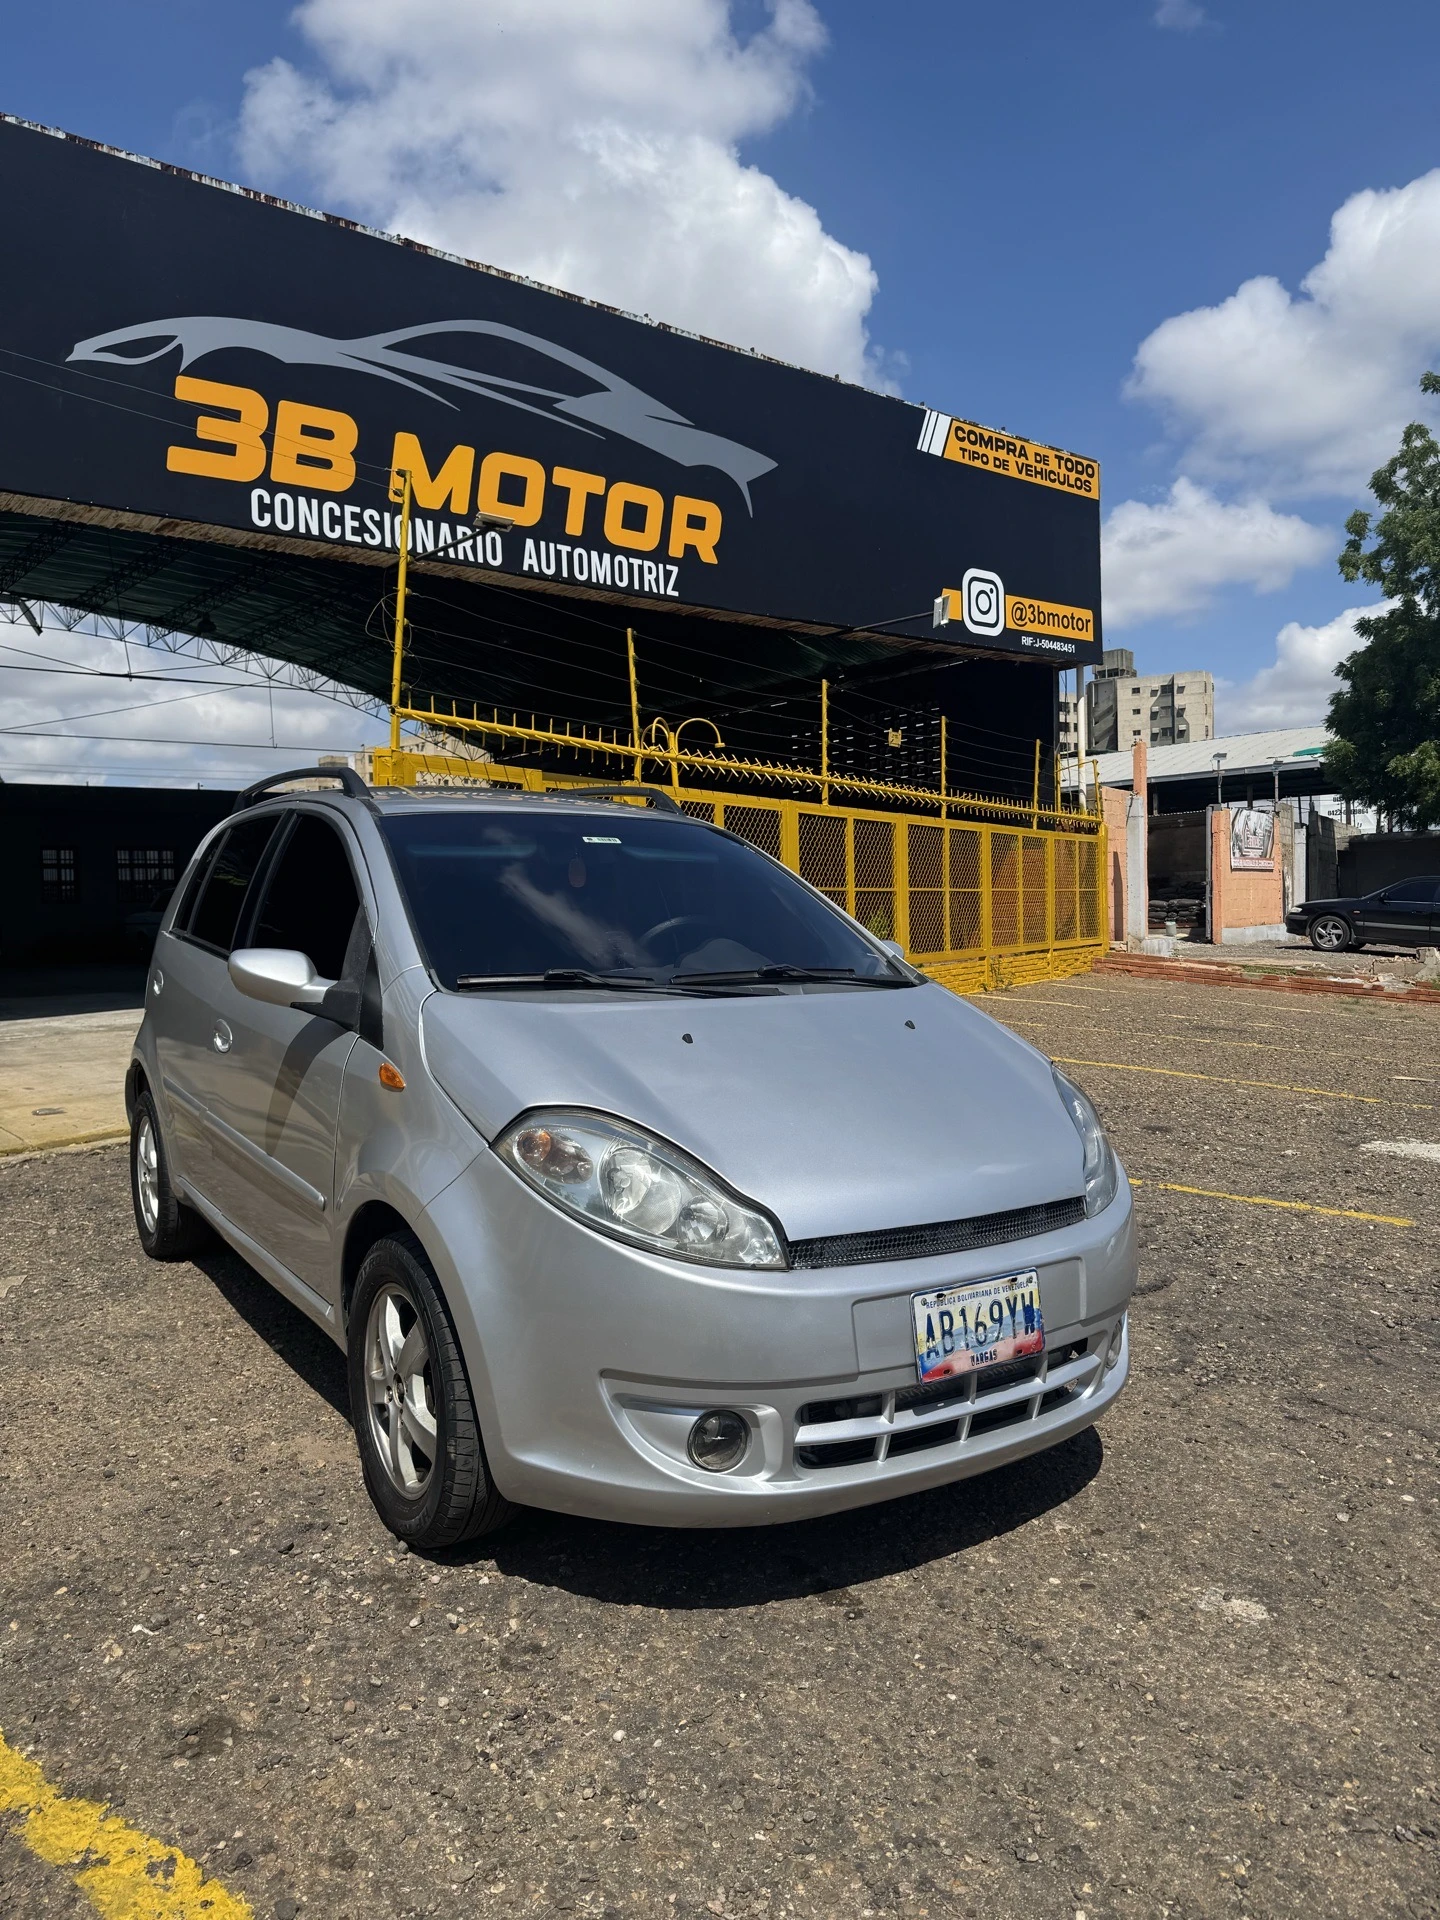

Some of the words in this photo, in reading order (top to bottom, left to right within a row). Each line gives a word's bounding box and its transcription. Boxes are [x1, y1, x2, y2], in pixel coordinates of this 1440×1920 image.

[166, 375, 359, 492] 3B
[388, 431, 723, 565] MOTOR
[954, 425, 1029, 461] COMPRA
[1034, 451, 1050, 467] DE
[1054, 454, 1095, 479] TODO
[959, 446, 990, 466] TIPO
[993, 456, 1010, 471] DE
[1015, 460, 1092, 493] VEHICULOS
[250, 488, 503, 567] CONCESIONARIO
[522, 538, 679, 597] AUTOMOTRIZ
[1011, 601, 1091, 633] @3bmotor
[957, 1289, 993, 1303] BOLIVARIANA
[993, 1287, 1001, 1295] DE
[1001, 1282, 1029, 1294] VENEZUELA
[970, 1349, 998, 1367] VARGAS
